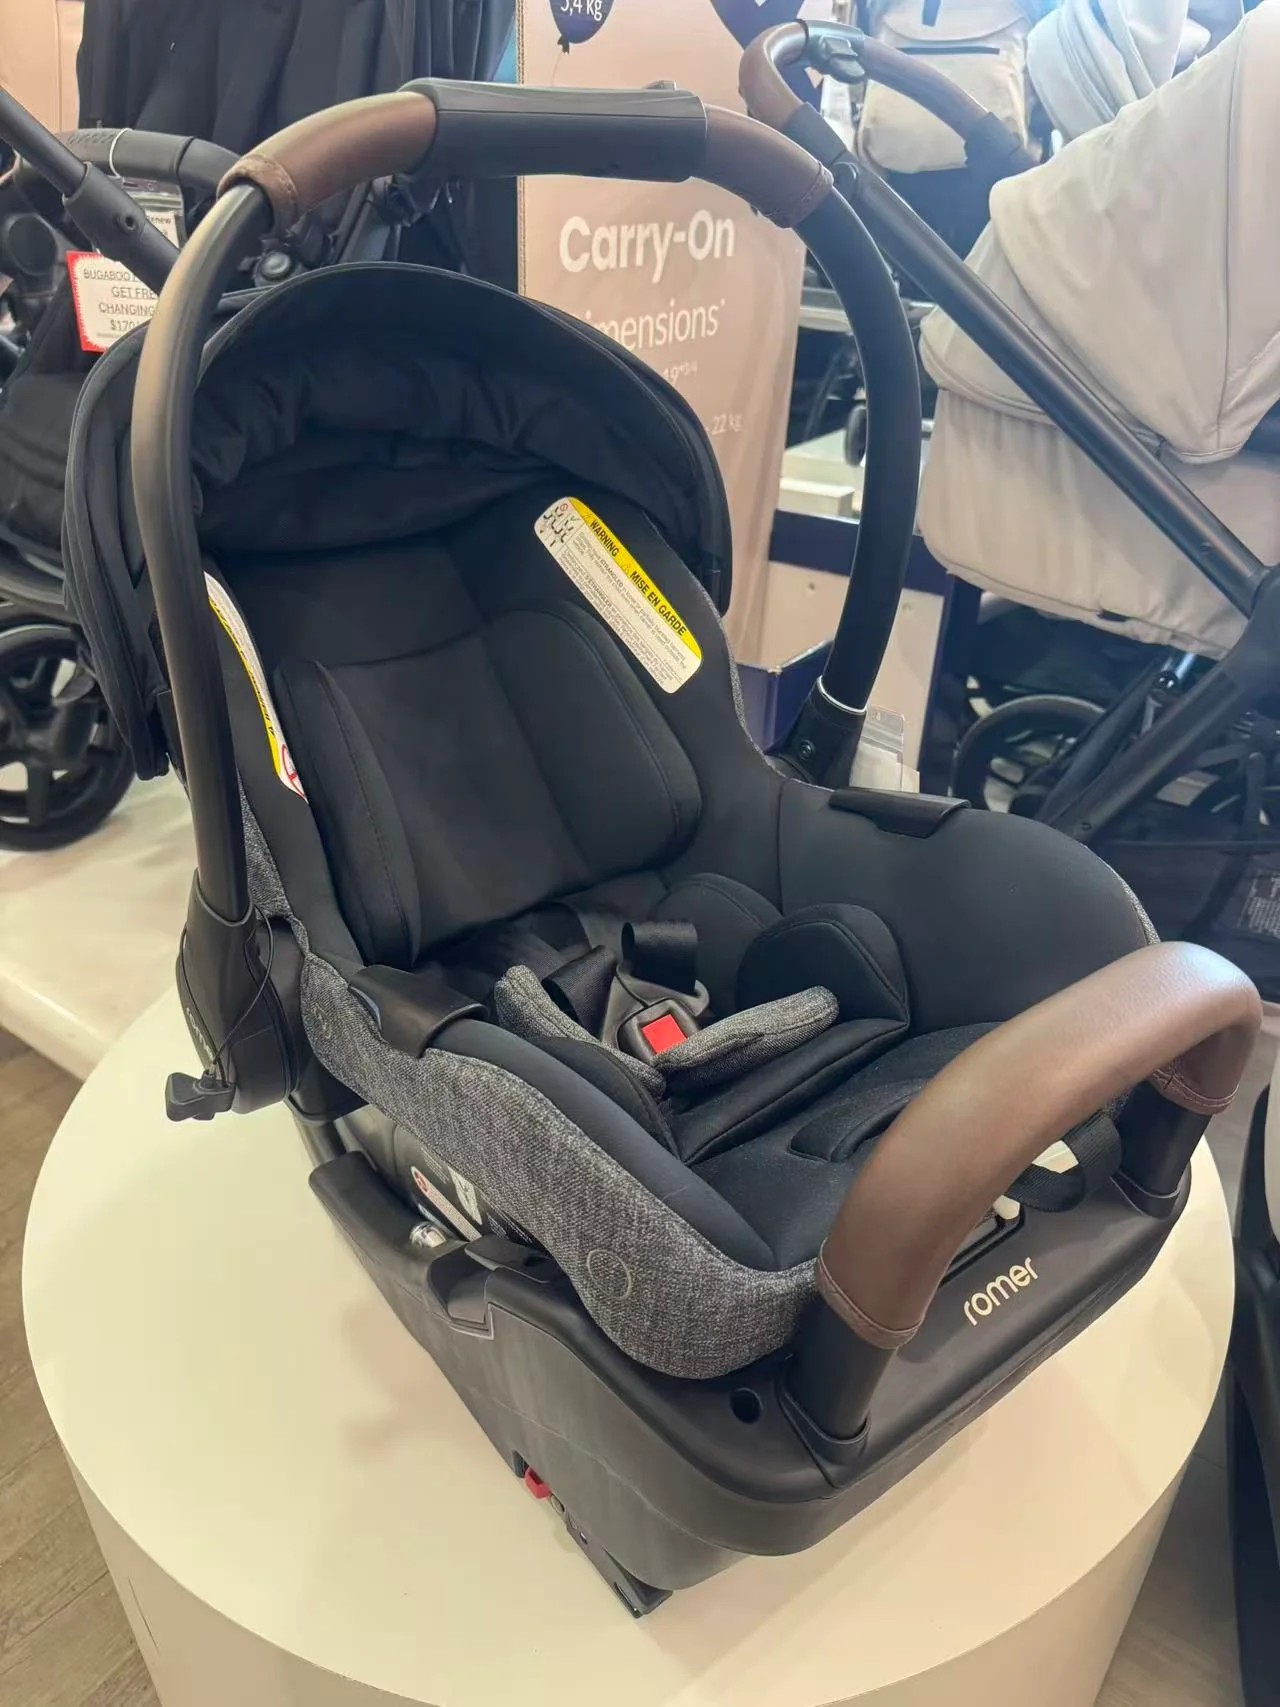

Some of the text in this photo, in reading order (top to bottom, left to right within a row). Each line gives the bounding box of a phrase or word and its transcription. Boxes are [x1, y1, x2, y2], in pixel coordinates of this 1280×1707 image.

[586, 0, 603, 21] kg
[560, 209, 735, 284] Carry-On
[83, 268, 131, 281] BUGABOO
[111, 286, 131, 298] GET
[99, 301, 156, 317] CHANGING
[590, 519, 619, 557] WARNING
[630, 571, 649, 594] MISE
[647, 592, 661, 607] EN
[658, 605, 686, 636] GARDE
[963, 1256, 1039, 1327] romer
